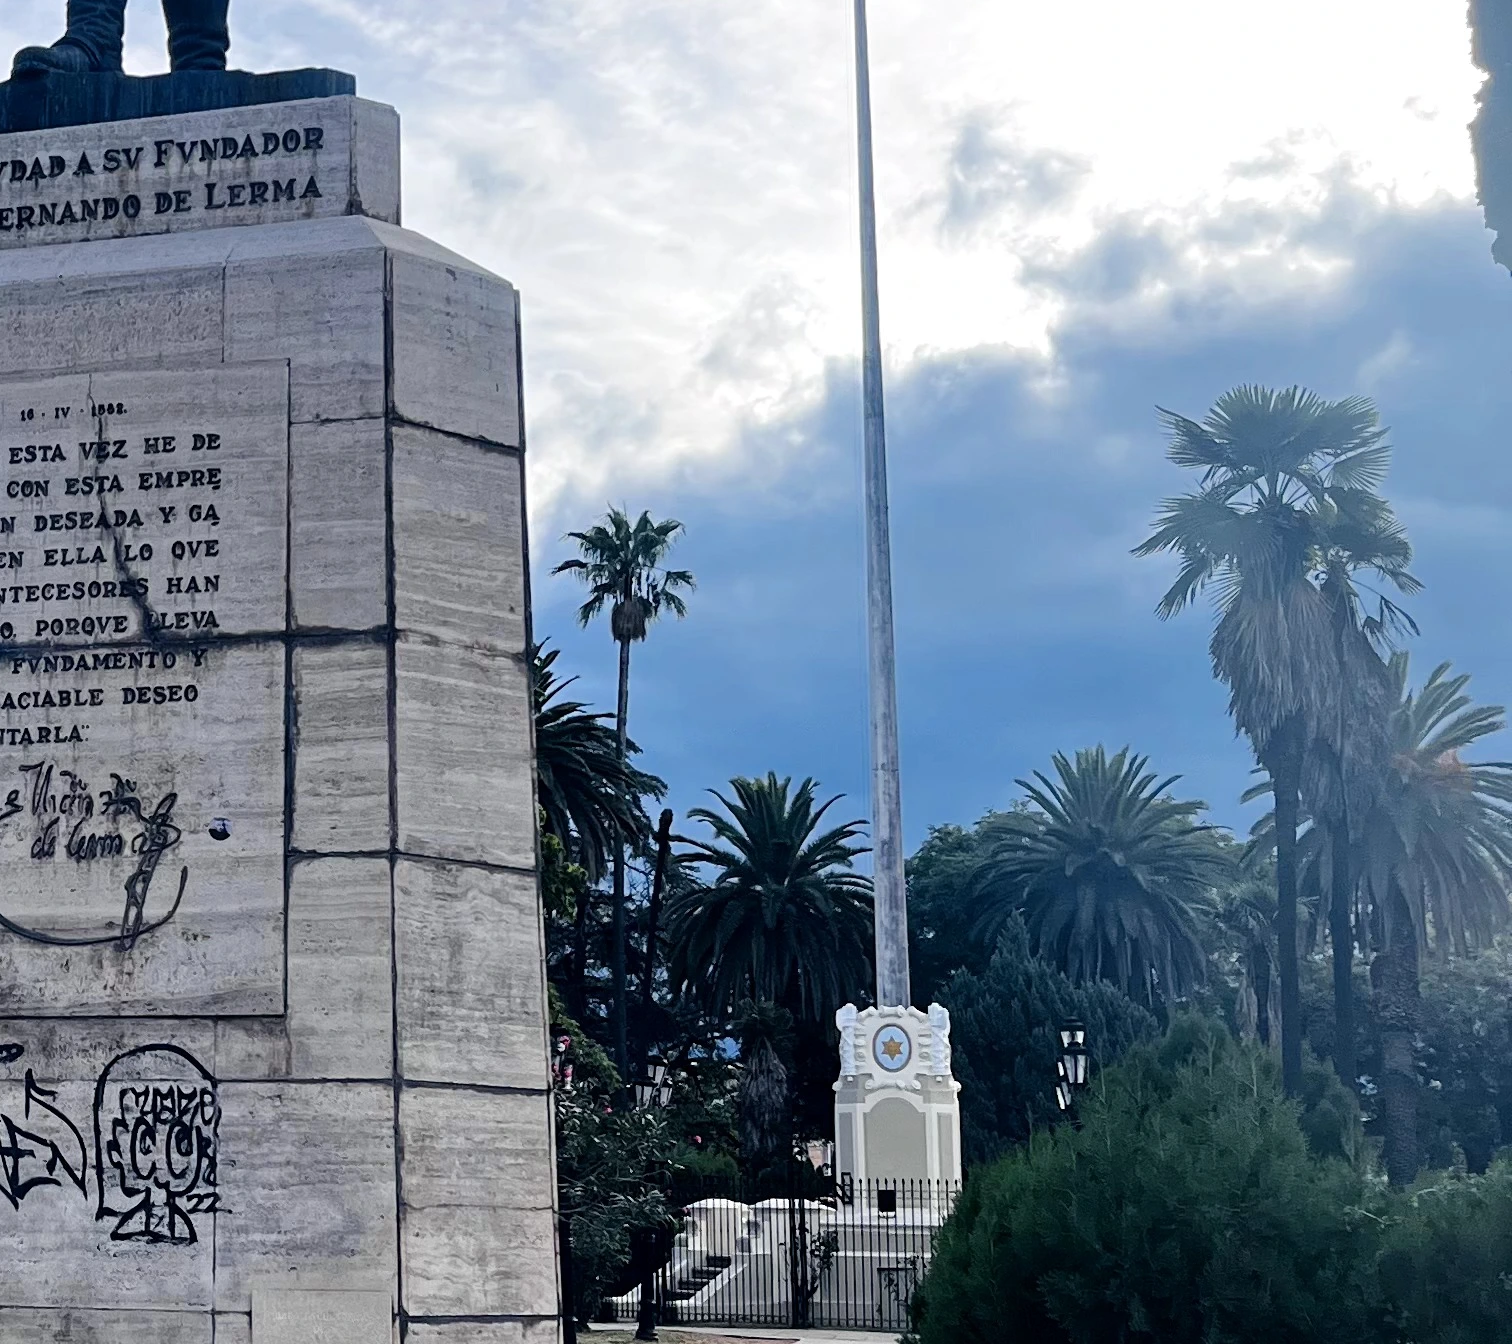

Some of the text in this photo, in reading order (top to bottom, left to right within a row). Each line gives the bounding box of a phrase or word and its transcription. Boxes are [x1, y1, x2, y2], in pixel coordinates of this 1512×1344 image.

[73, 151, 95, 177] A
[103, 147, 144, 173] SV
[155, 127, 324, 167] FVNDADOR
[155, 189, 193, 216] DE
[205, 176, 323, 210] LERMA
[9, 444, 66, 465] ESTA
[79, 439, 128, 460] VEZ
[143, 436, 176, 455] HE
[191, 433, 221, 451] DE
[7, 480, 49, 498] CON
[65, 474, 124, 495] ESTA
[34, 509, 143, 532] DESEADA
[159, 506, 176, 524] Y
[43, 546, 107, 567] ELLA
[123, 543, 153, 561] LO
[166, 575, 220, 594] HAN
[35, 615, 128, 637] PORQVE
[148, 609, 220, 631] LLEVA
[12, 650, 176, 675] FVNDAMENTO
[191, 648, 208, 667] Y
[122, 685, 199, 706] DESEO
